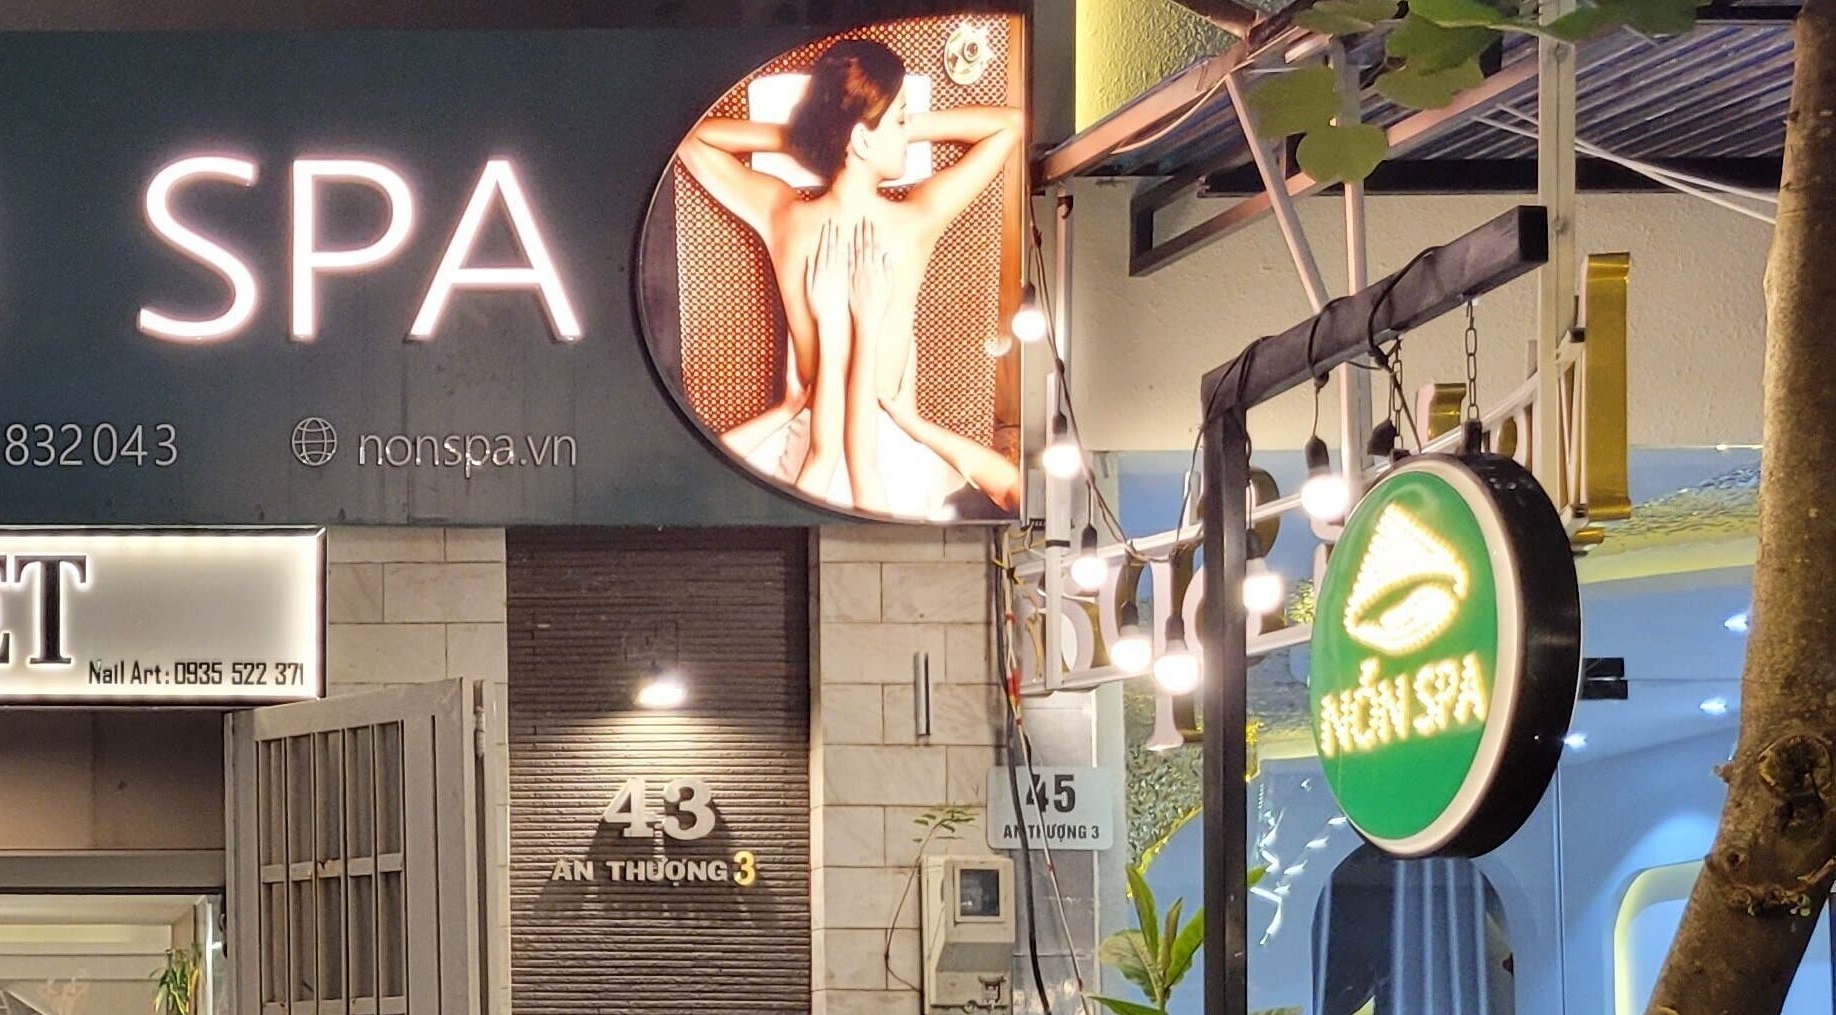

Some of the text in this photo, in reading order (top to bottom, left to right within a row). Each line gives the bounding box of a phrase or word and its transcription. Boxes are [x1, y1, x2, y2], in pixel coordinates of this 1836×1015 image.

[138, 156, 585, 343] SPA
[359, 433, 578, 478] nonspa.vn
[88, 659, 125, 685] Nail
[174, 661, 223, 686] 0935
[232, 662, 268, 686] 522
[275, 662, 304, 686] 371
[1320, 652, 1489, 757] NÓN SPA
[603, 777, 716, 841] 43
[1026, 774, 1076, 813] 45
[1092, 825, 1100, 840] 3
[551, 858, 594, 881] AN
[733, 850, 756, 887] 3
